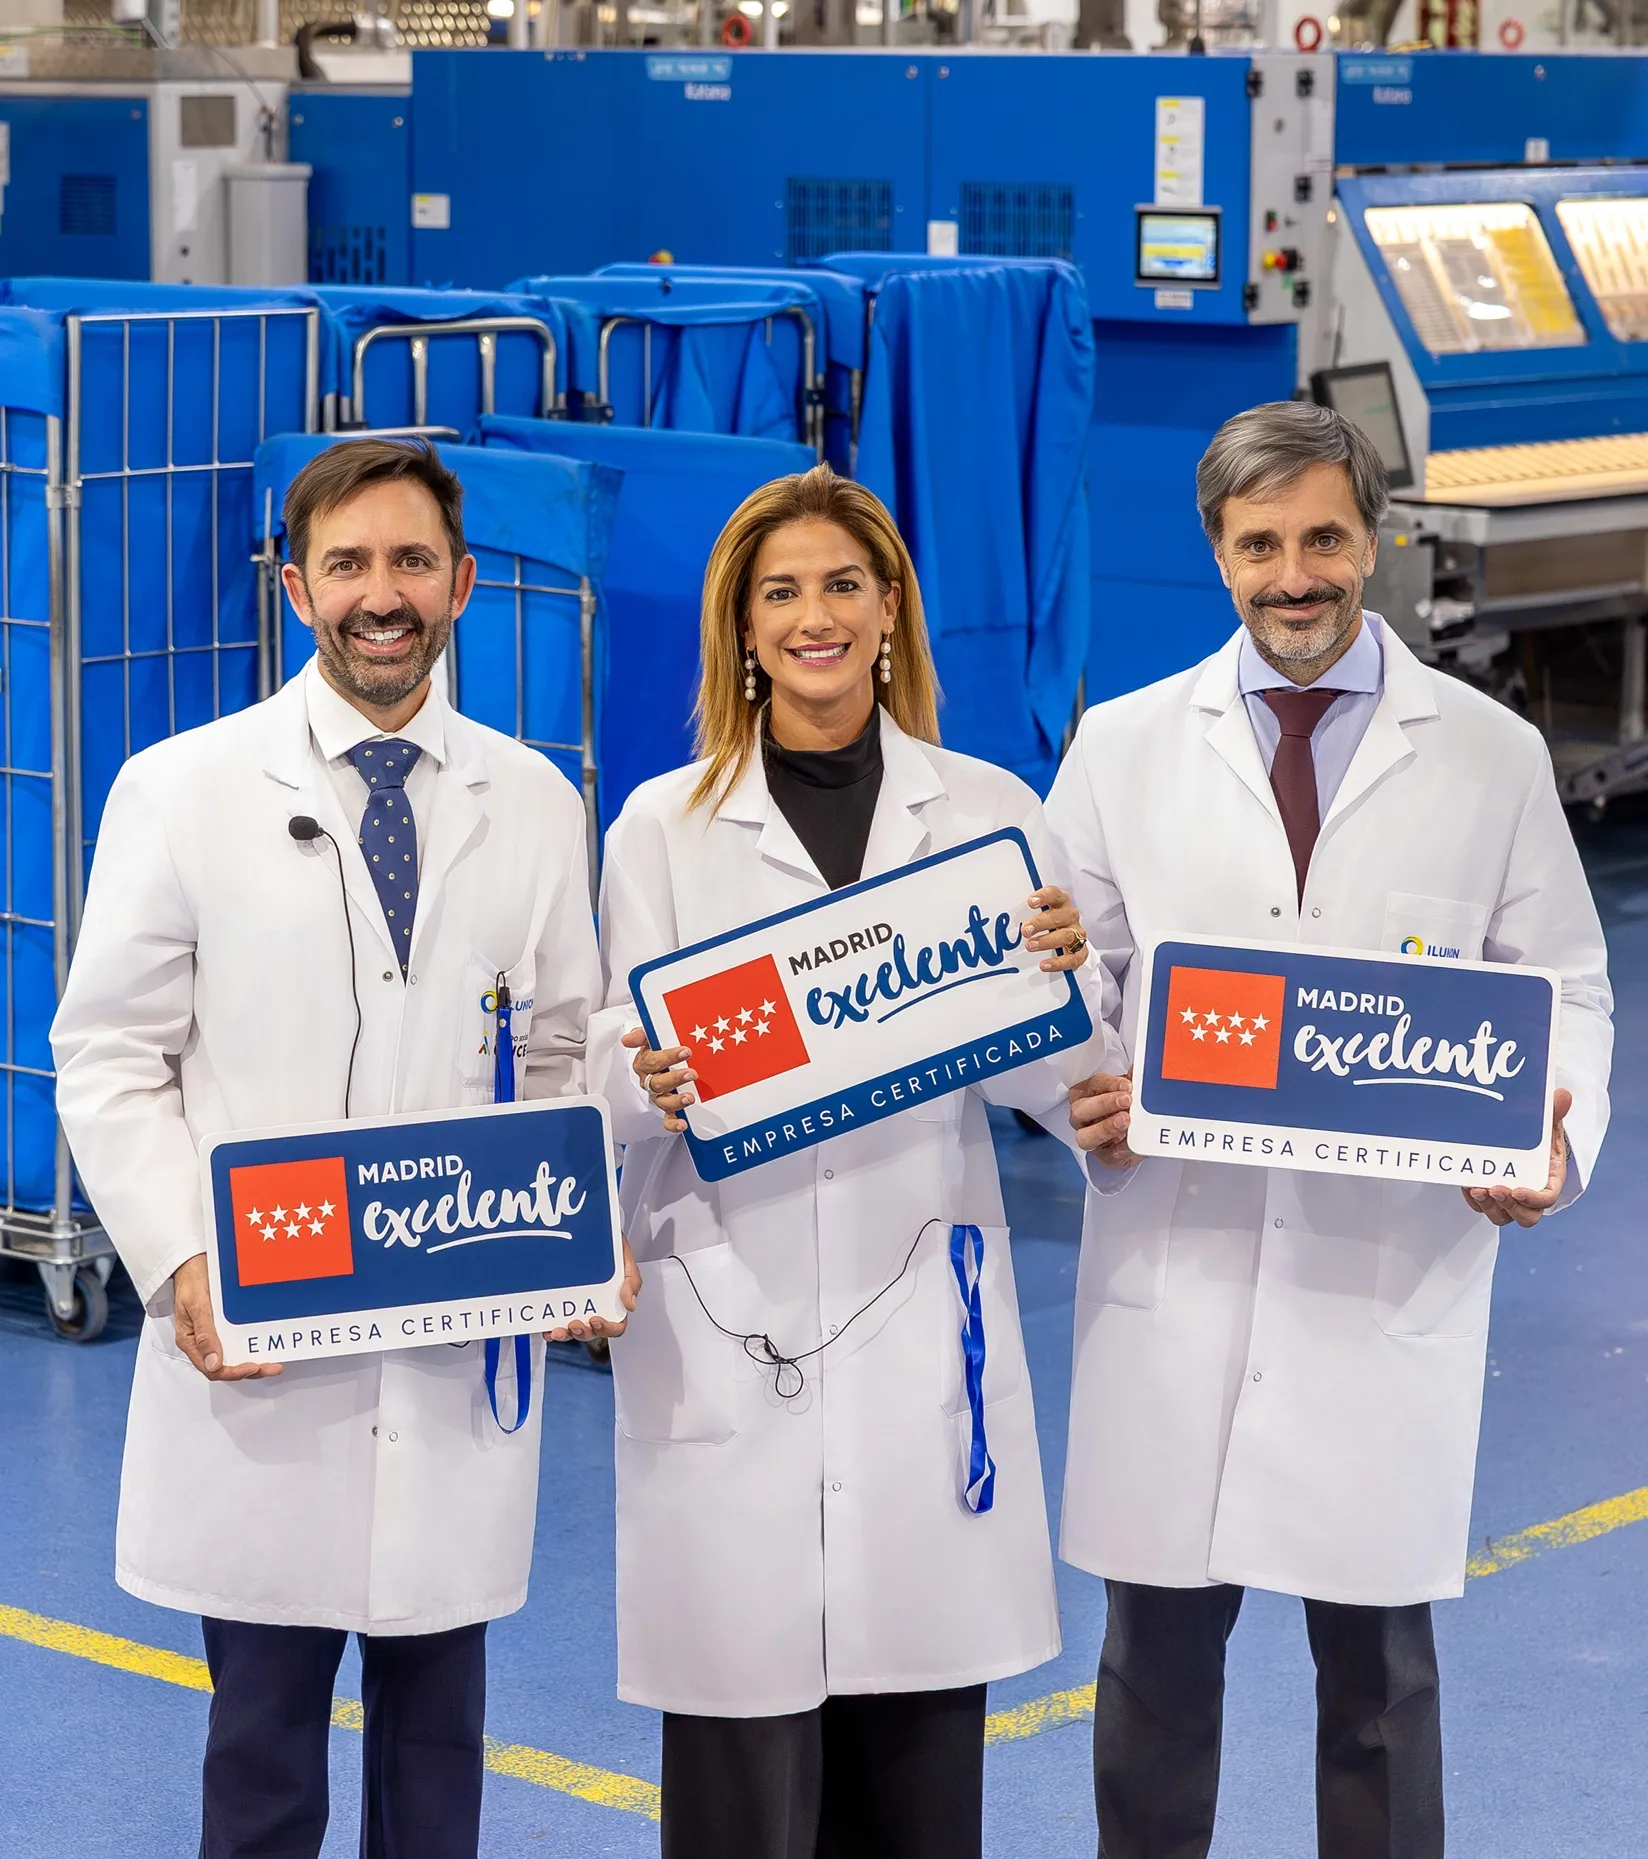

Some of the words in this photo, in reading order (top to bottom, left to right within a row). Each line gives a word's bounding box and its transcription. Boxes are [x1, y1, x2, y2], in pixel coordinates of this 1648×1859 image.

[788, 922, 894, 977] MADRID
[806, 904, 1023, 1030] excelente
[1296, 987, 1406, 1017] MADRID
[1293, 1014, 1526, 1086] excelente
[722, 1104, 855, 1164] EMPRESA
[870, 1023, 1063, 1108] CERTIFICADA
[357, 1154, 463, 1186] MADRID
[1159, 1128, 1295, 1158] EMPRESA
[1315, 1142, 1518, 1179] CERTIFICADA
[362, 1160, 588, 1249] excelente
[247, 1323, 383, 1354] EMPRESA
[401, 1298, 598, 1336] CERTIFICADA
